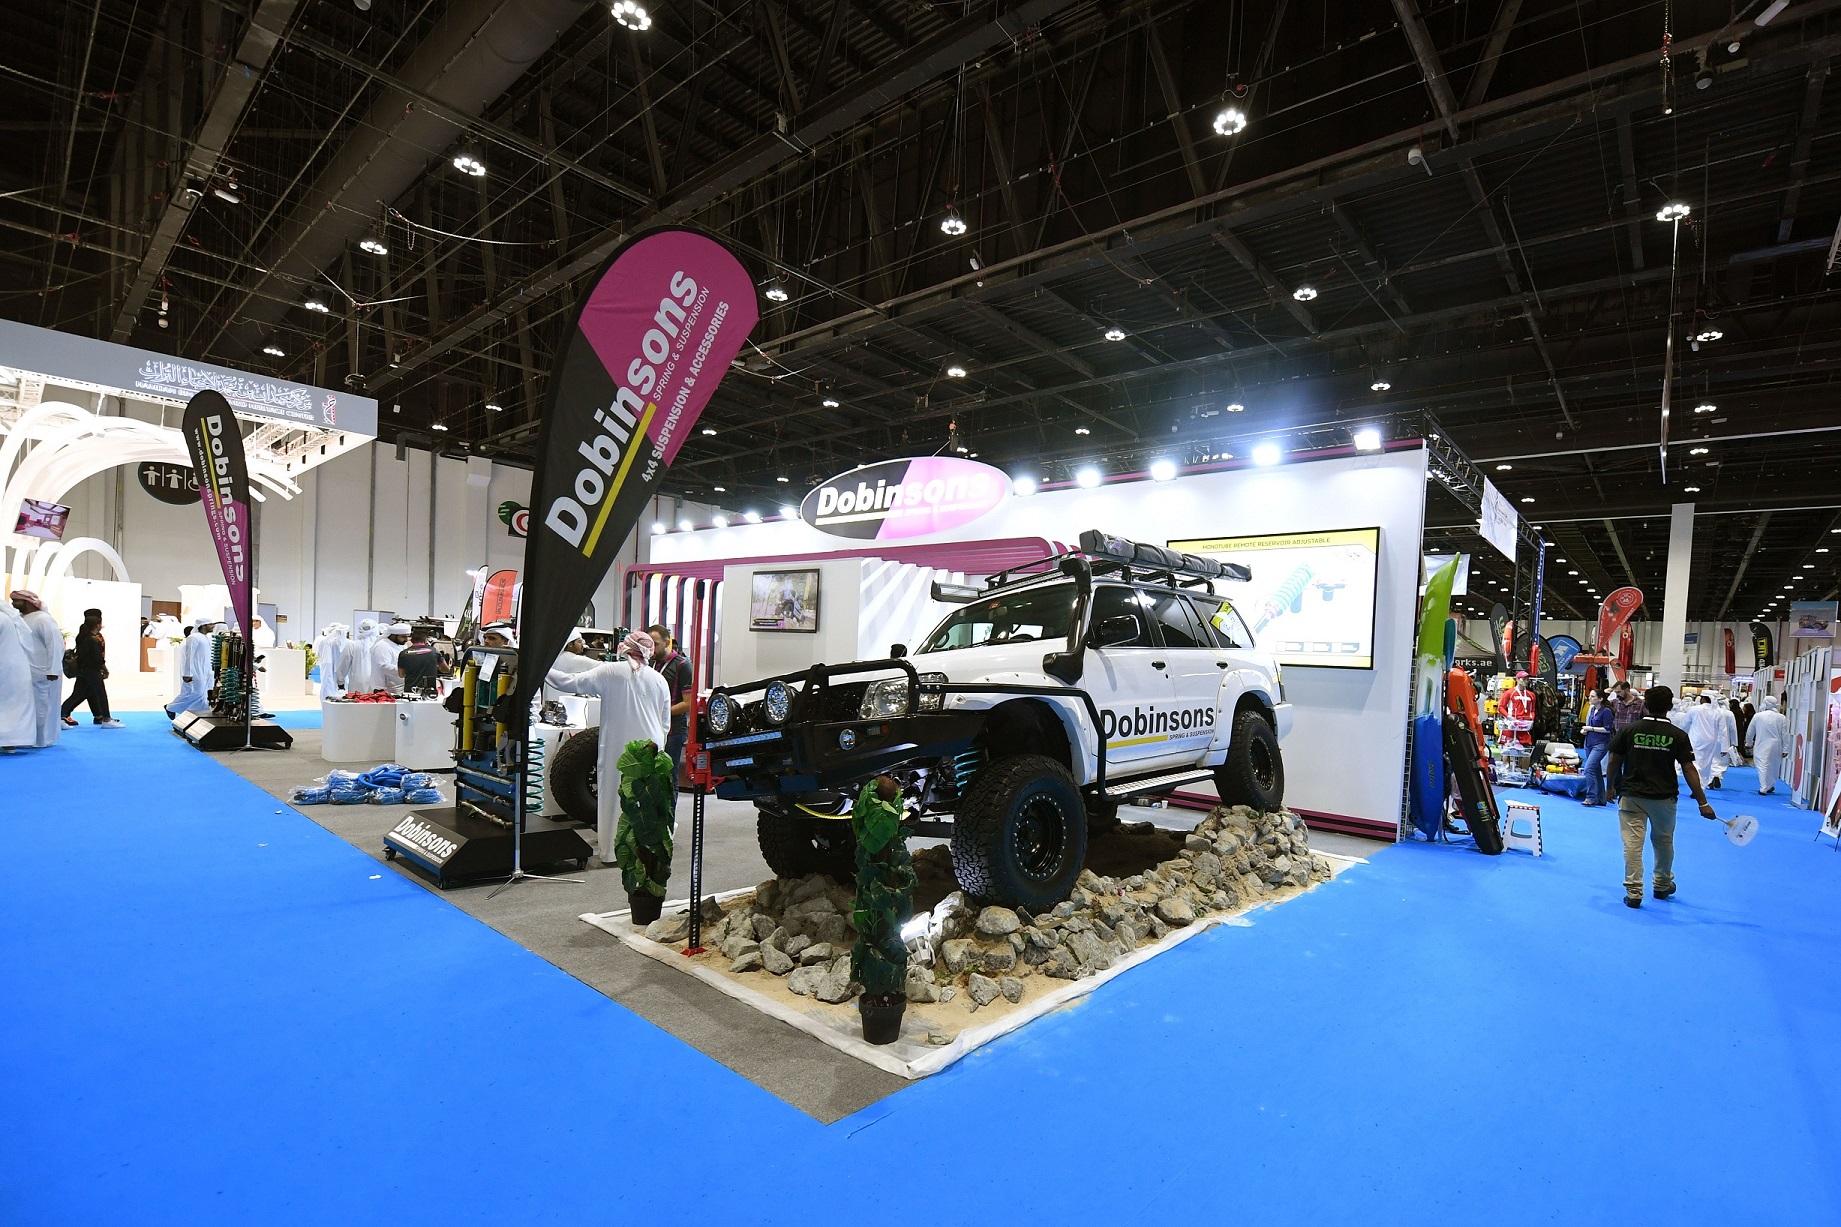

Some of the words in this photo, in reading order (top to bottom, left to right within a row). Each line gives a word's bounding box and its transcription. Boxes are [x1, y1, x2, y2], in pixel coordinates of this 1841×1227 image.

[653, 361, 675, 401] SPRING
[671, 352, 680, 361] &
[676, 286, 710, 351] SUSPENSION
[689, 300, 730, 377] ACCESSORIES
[684, 376, 696, 387] &
[545, 270, 698, 549] Dobinsons
[651, 386, 691, 460] SUSPENSION
[641, 459, 659, 482] 4x4
[206, 414, 245, 582] Dobinsons
[817, 472, 992, 516] Dobinsons
[1257, 539, 1292, 547] RESERVOIR
[1292, 537, 1331, 545] ADJUSTABLE
[224, 543, 236, 586] SUSPENSION
[1100, 706, 1215, 739] Dobinsons
[1189, 729, 1215, 738] SUSPENSION
[393, 815, 458, 858] Dobinsons
